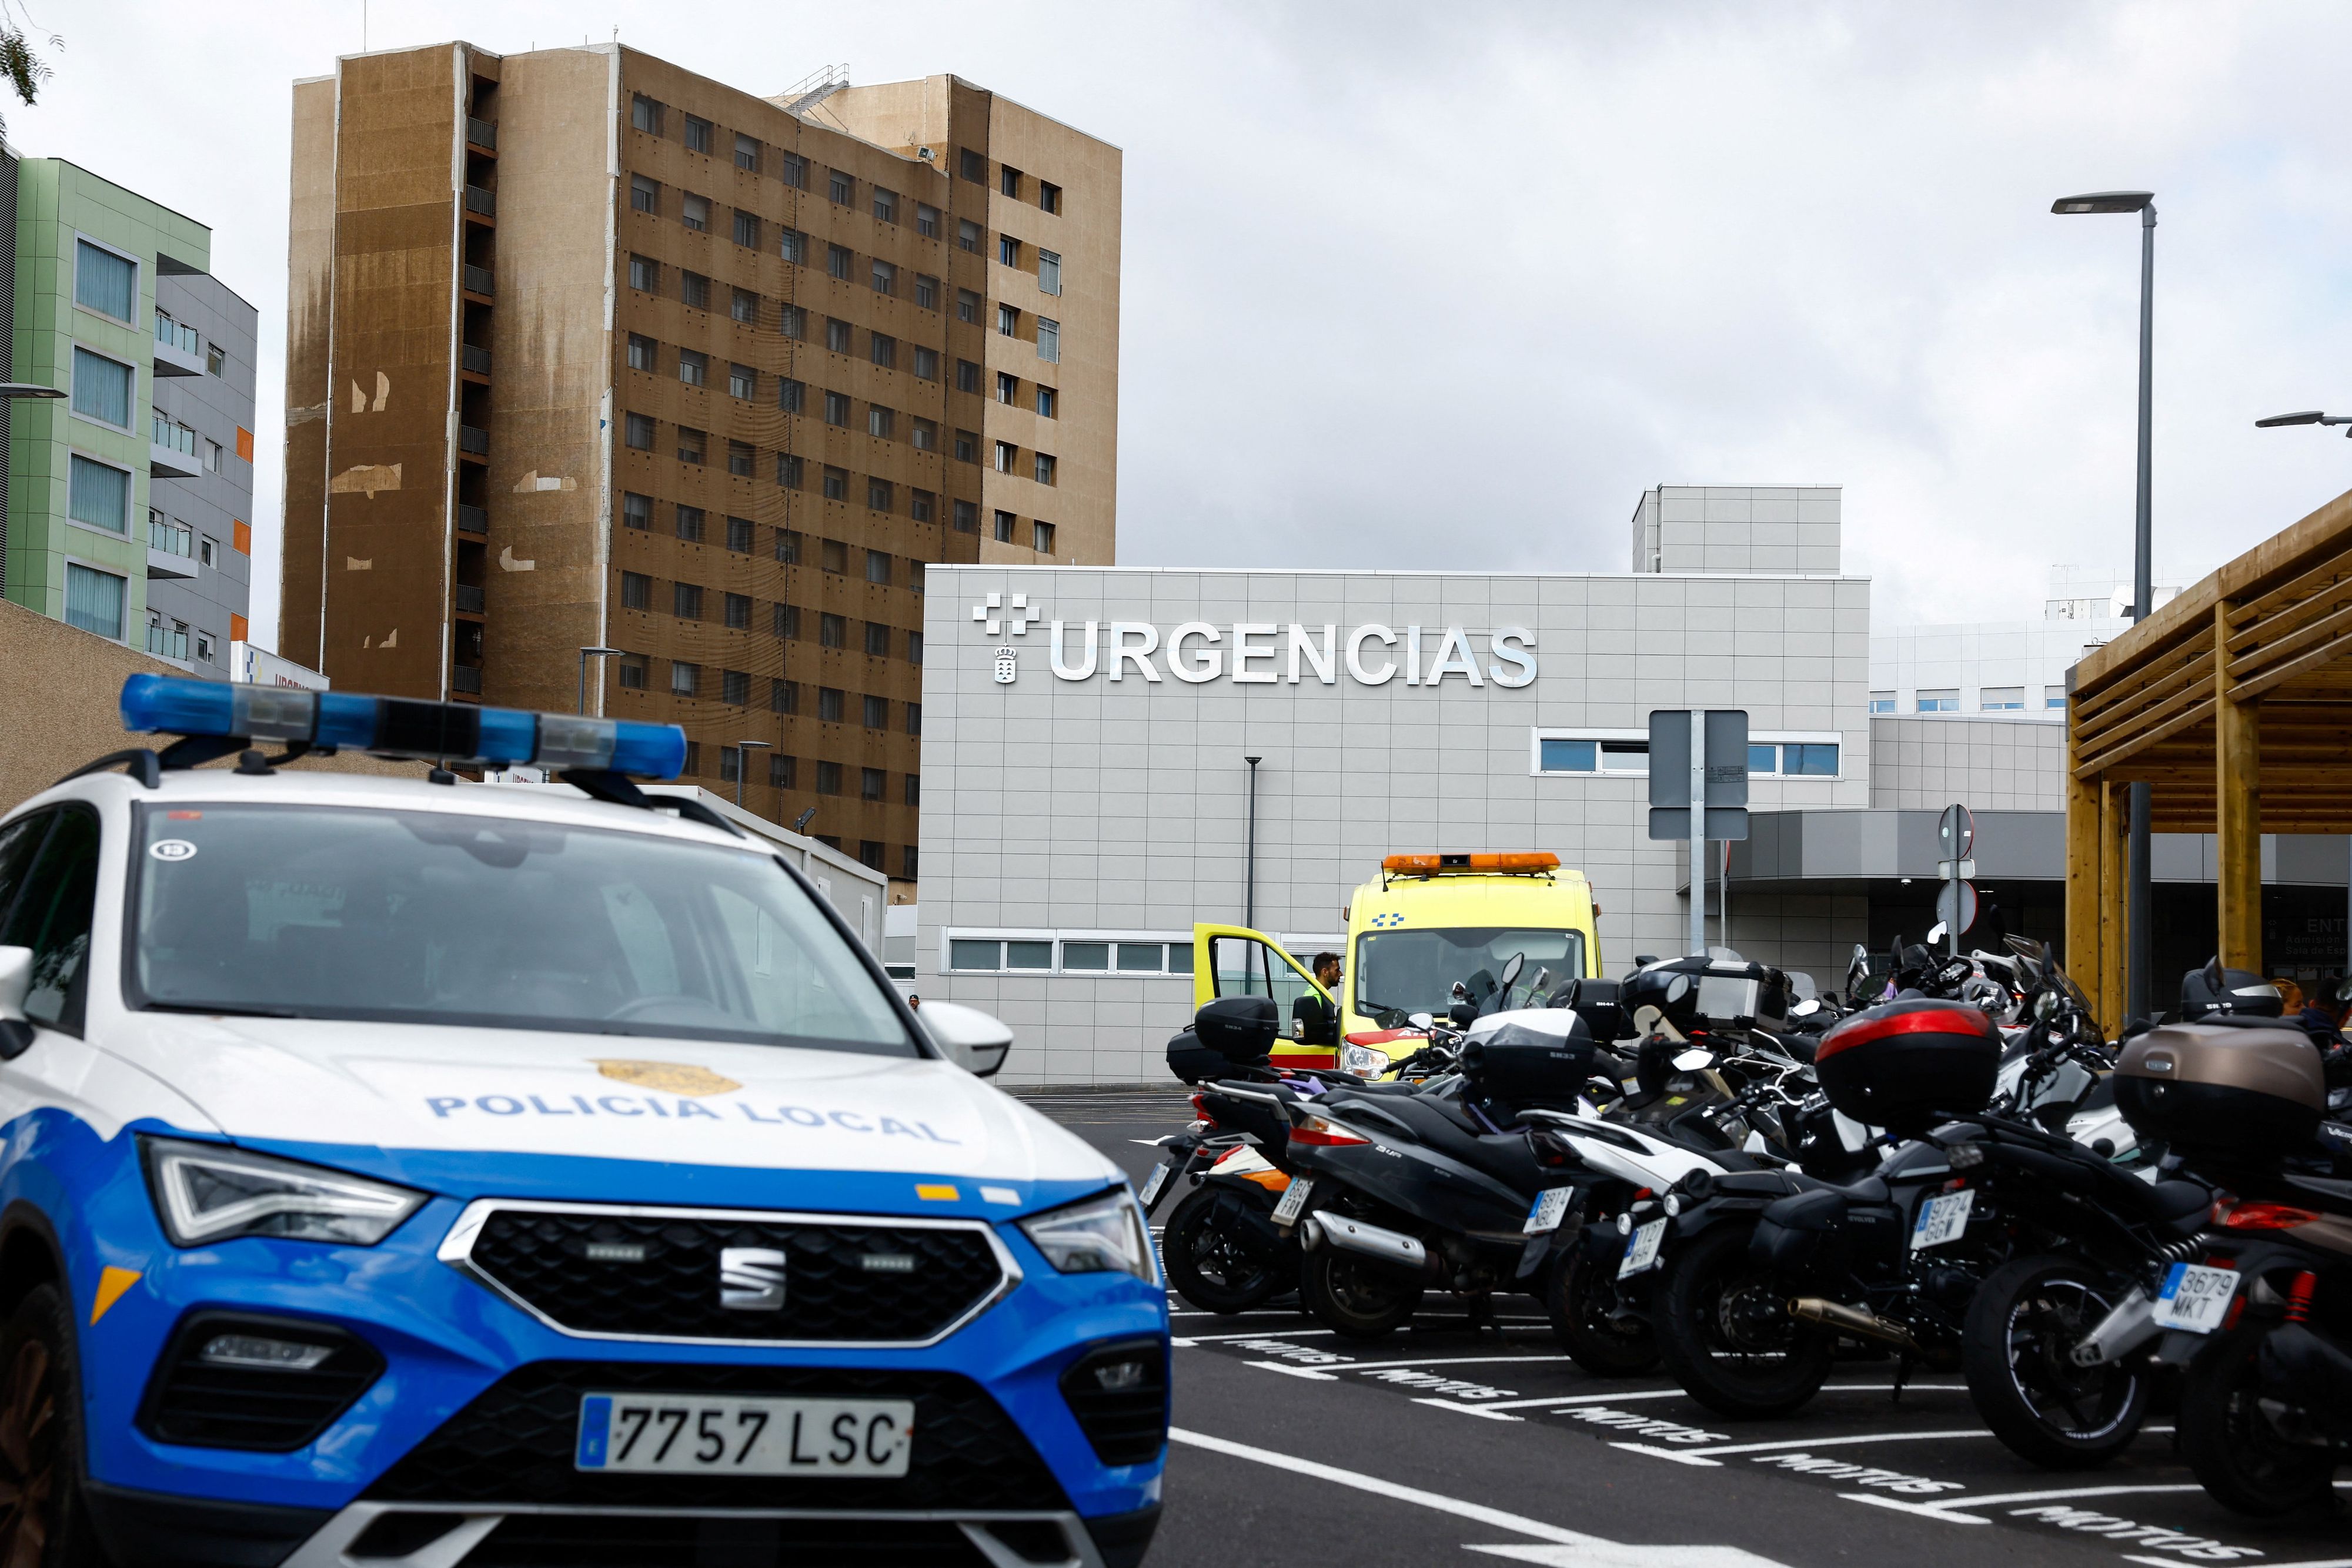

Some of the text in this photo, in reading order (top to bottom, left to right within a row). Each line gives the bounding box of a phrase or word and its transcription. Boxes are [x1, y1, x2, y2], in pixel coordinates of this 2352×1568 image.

[1050, 620, 1538, 687] URGENCIAS
[2307, 918, 2348, 932] ENT
[2311, 946, 2324, 954] de
[424, 1094, 963, 1145] POLICIA LOCAL
[1932, 1195, 1968, 1221] 9724
[2181, 1271, 2233, 1296] 3679
[2171, 1296, 2211, 1319] MKT
[1222, 1340, 1355, 1363] MOTOS
[1359, 1369, 1519, 1398] MOTOS
[616, 1409, 895, 1466] 7757 LSC
[1551, 1406, 1732, 1443] MOTOS
[1750, 1453, 1966, 1493] MOTOS
[2007, 1506, 2265, 1559] MOTOS
